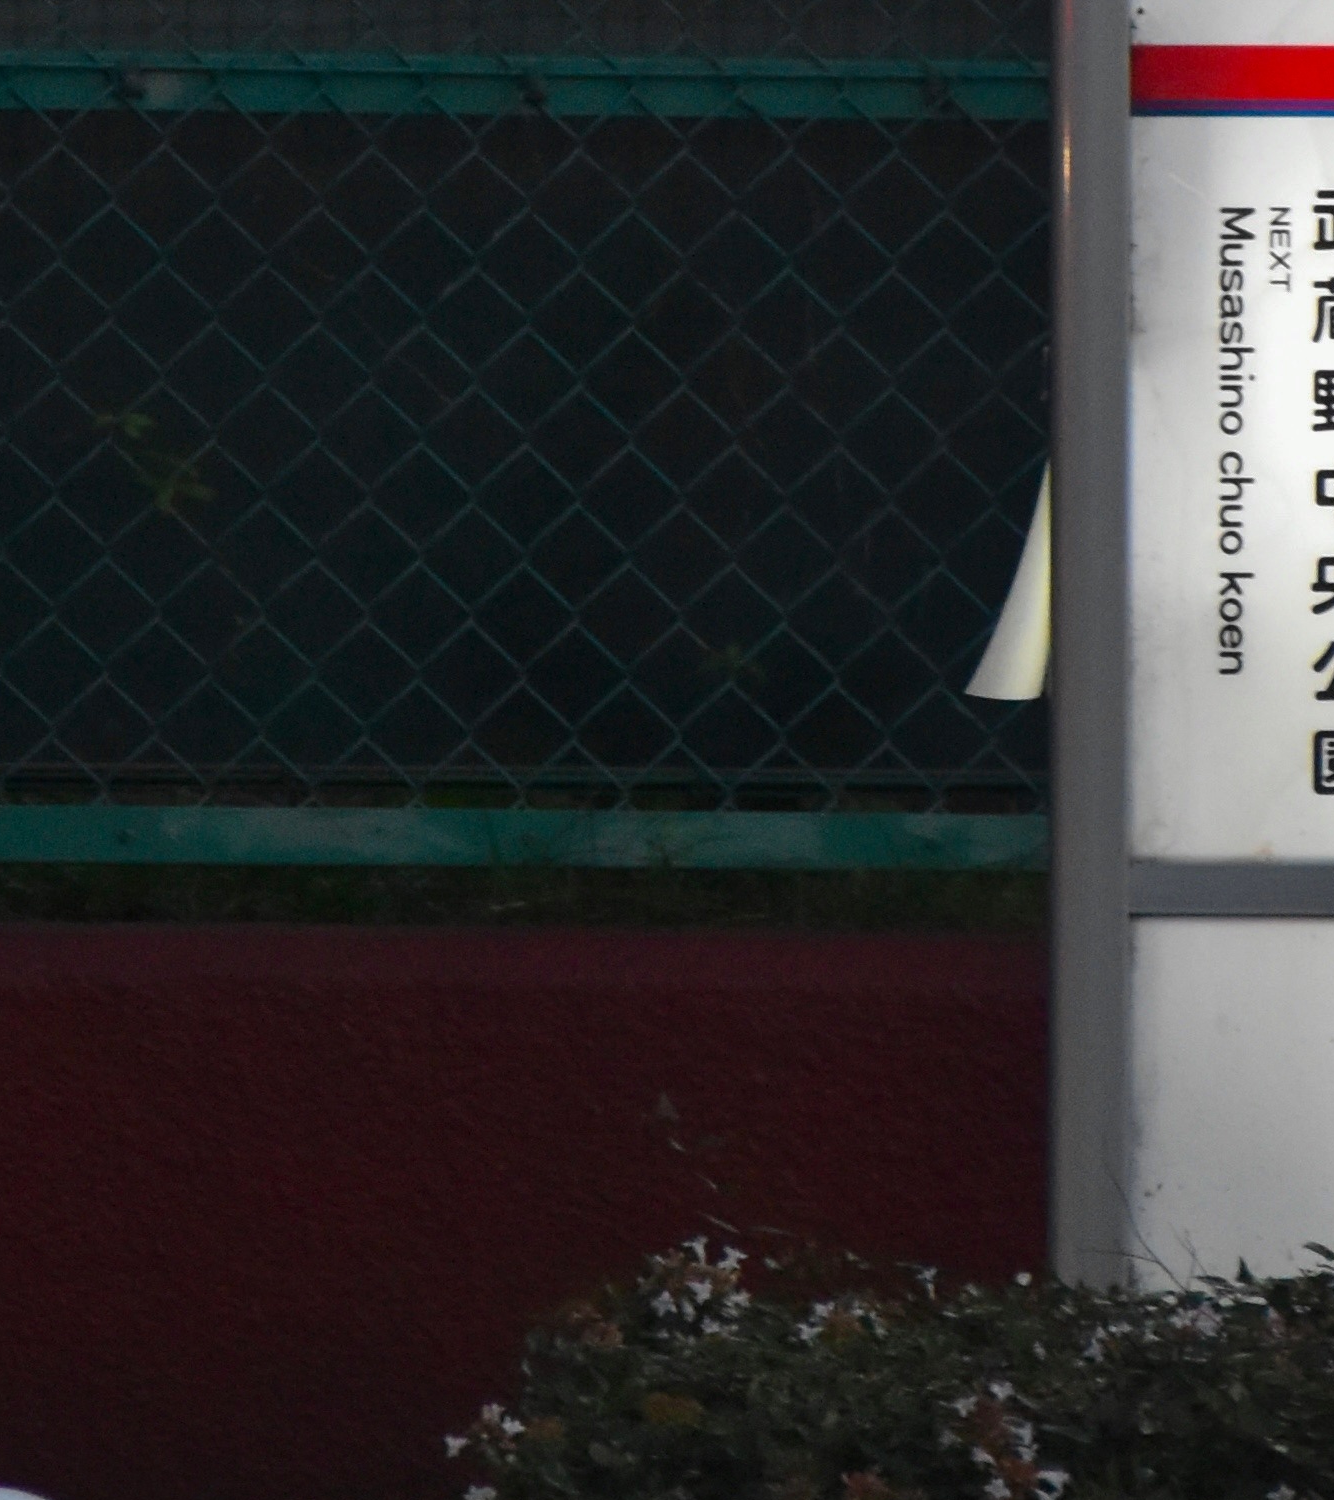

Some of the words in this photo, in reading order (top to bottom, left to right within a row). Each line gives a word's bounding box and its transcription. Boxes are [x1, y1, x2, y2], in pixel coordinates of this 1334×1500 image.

[1268, 206, 1294, 294] NEXT
[1217, 206, 1258, 438] Musashino
[1217, 450, 1258, 558] chuo
[1217, 570, 1258, 679] koen
